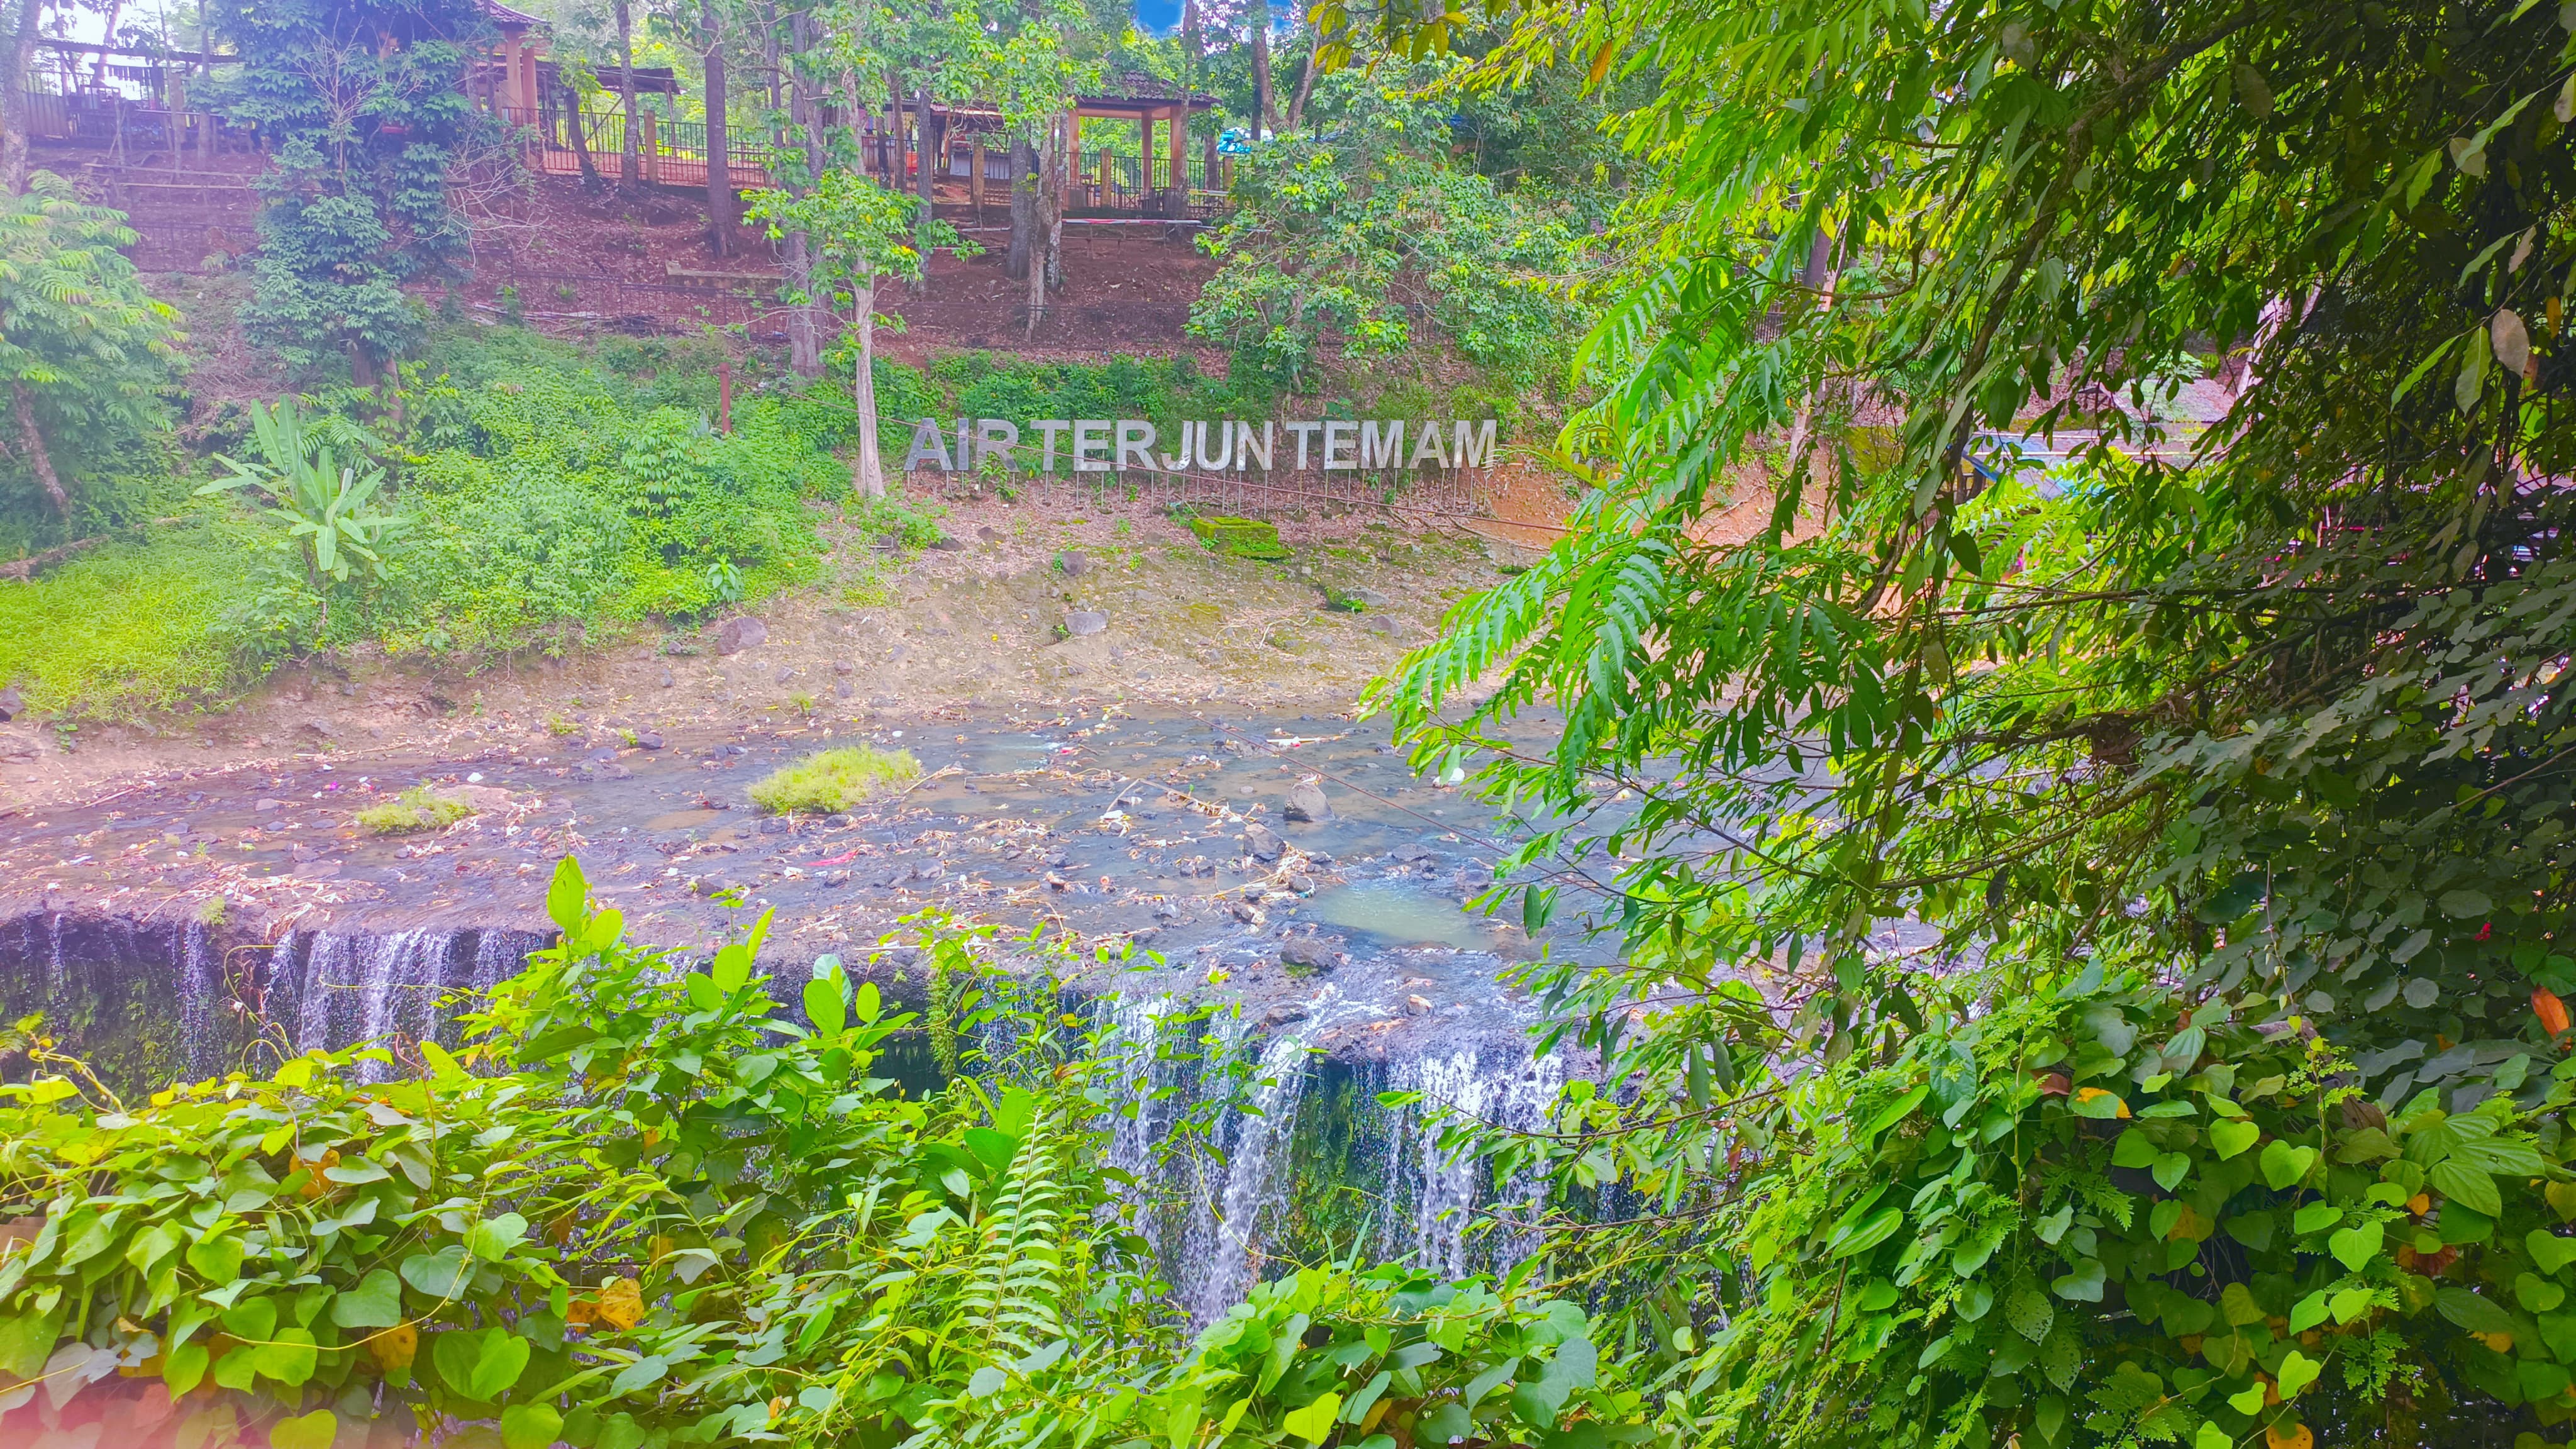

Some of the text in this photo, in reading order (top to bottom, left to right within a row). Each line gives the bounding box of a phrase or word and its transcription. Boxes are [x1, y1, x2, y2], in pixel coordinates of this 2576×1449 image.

[903, 417, 1497, 472] AIR TERJUN TEMAM
